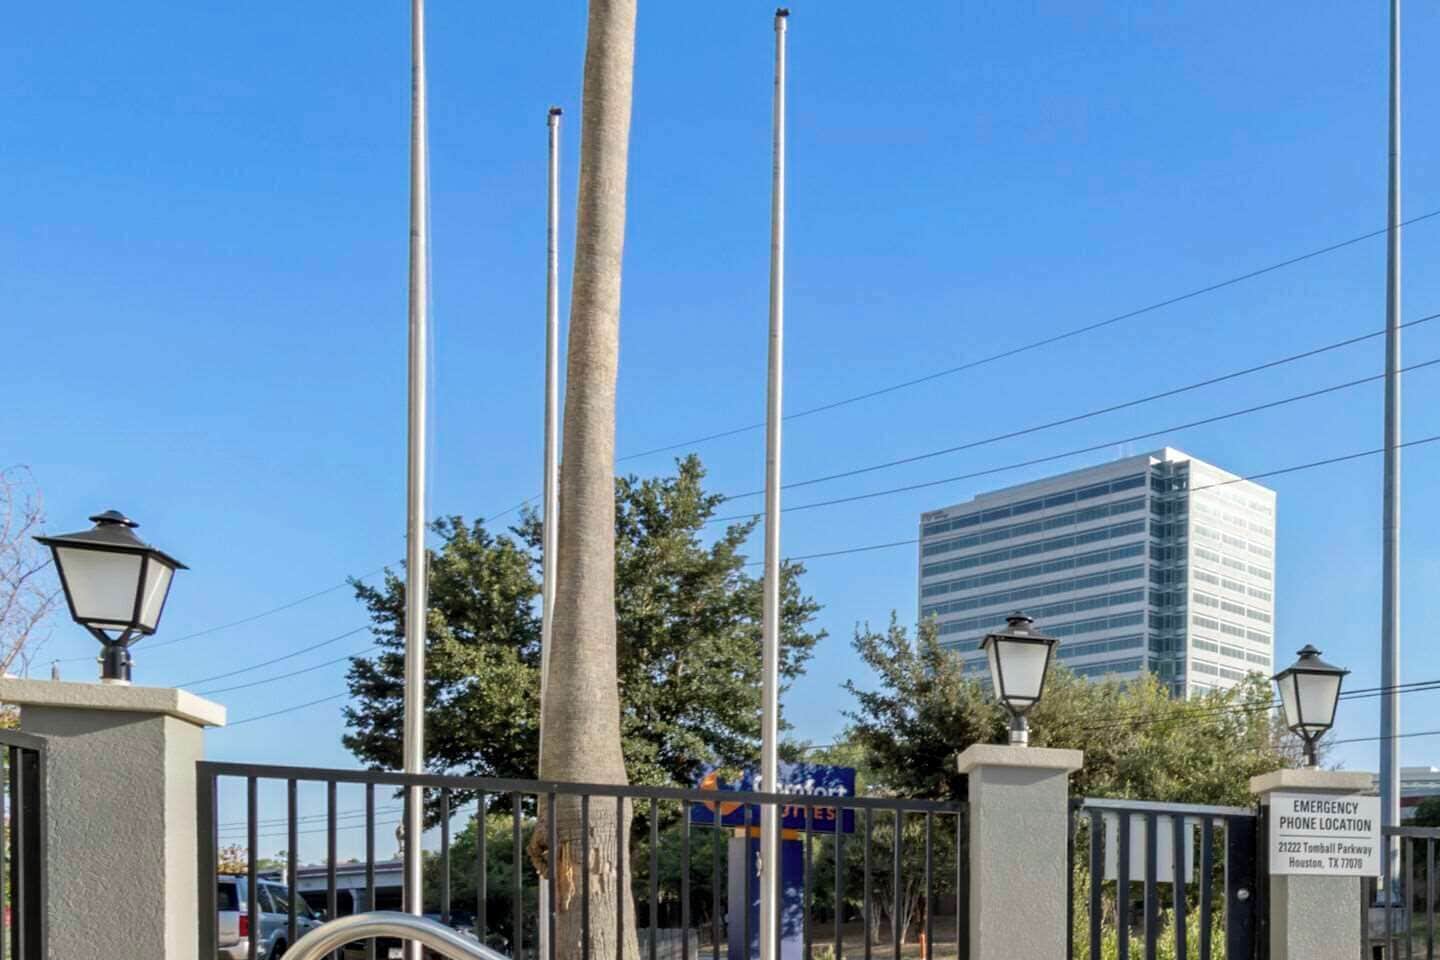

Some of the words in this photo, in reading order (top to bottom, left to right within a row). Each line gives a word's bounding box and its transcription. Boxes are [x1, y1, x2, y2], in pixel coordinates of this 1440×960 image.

[753, 775, 847, 797] Cmfort
[1293, 800, 1359, 815] EMERGENCY
[1279, 816, 1317, 830] PHONE
[1320, 818, 1372, 832] LOCATION
[1278, 842, 1301, 853] 21222
[1303, 842, 1336, 854] Tomball
[1337, 843, 1373, 857] Parkway
[1289, 857, 1325, 869] Houston,
[1328, 857, 1339, 869] TX
